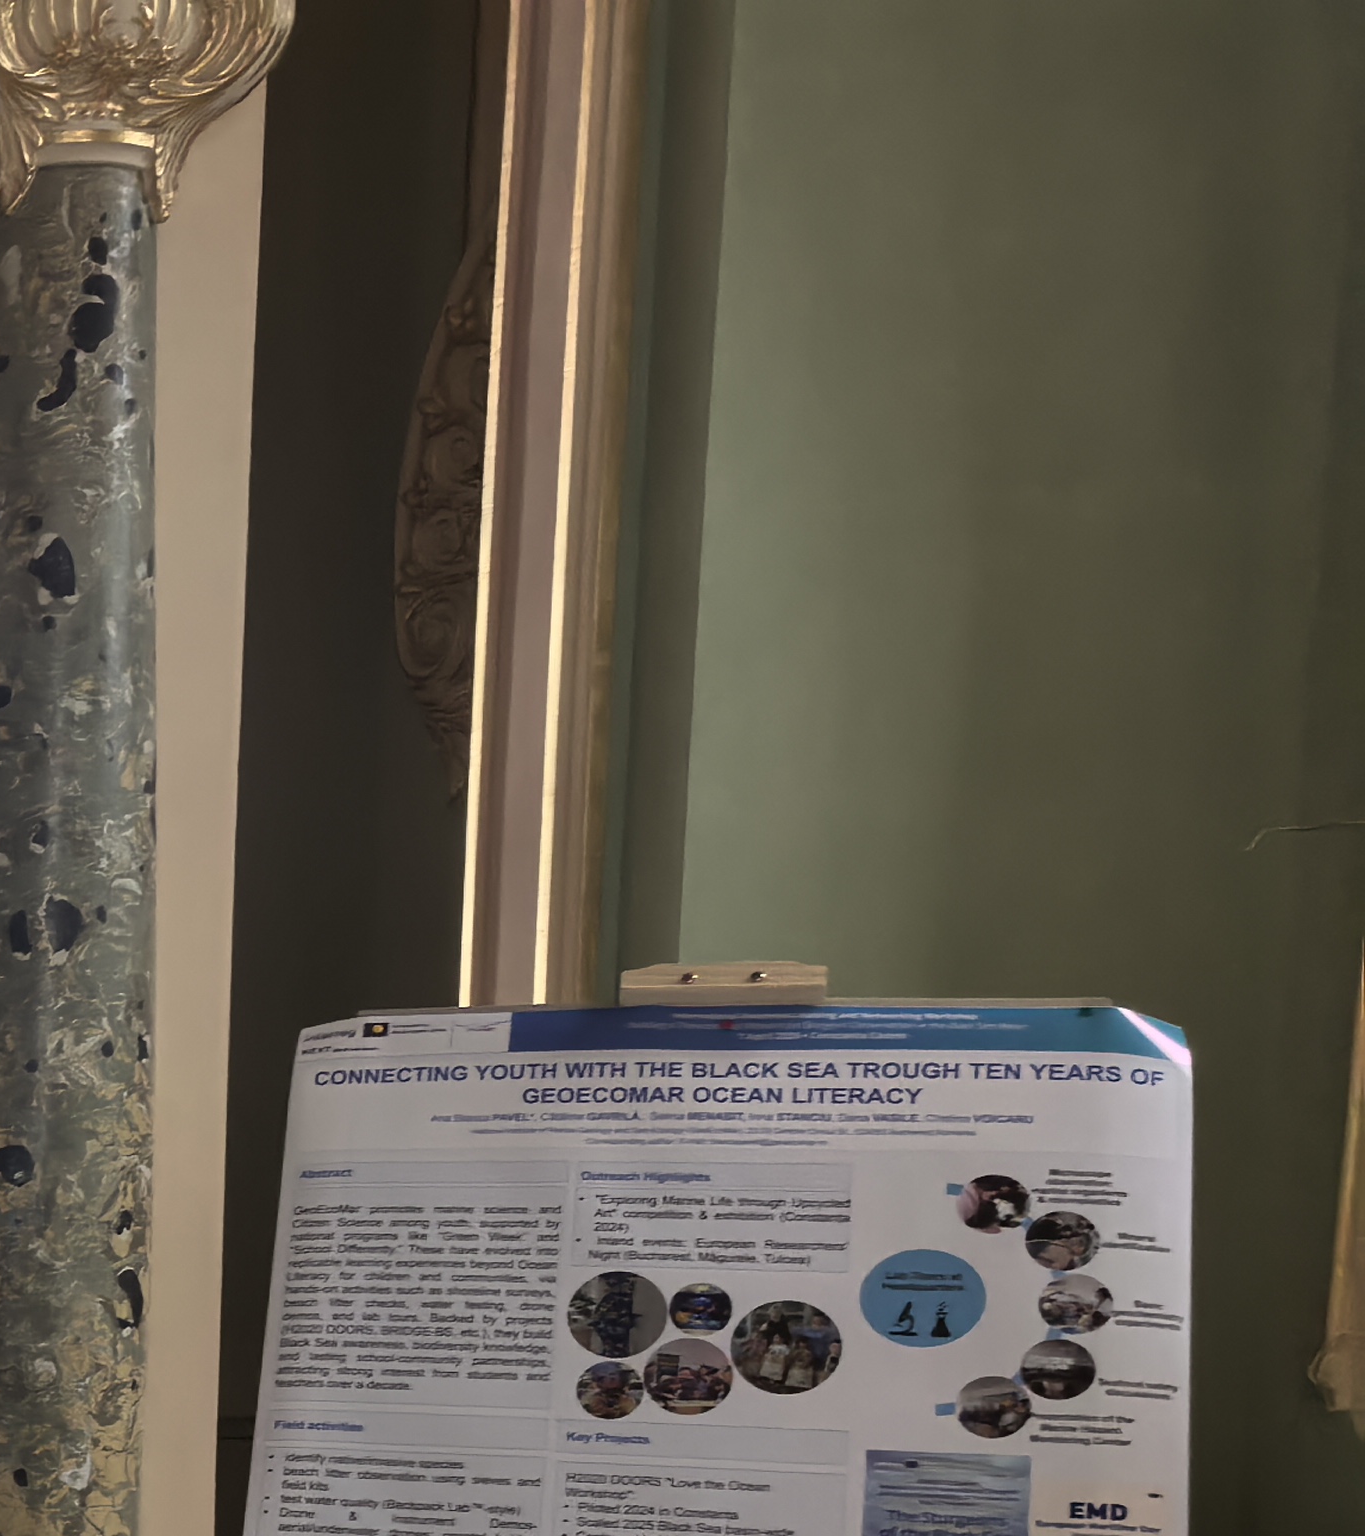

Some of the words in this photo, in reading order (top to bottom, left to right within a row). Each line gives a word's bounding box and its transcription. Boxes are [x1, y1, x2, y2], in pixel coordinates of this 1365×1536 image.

[315, 1066, 468, 1086] CONNECTING
[475, 1063, 557, 1080] YOUTH
[565, 1062, 626, 1078] WITH
[634, 1062, 684, 1078] THE
[691, 1063, 779, 1078] BLACK
[787, 1062, 839, 1078] SEA
[848, 1062, 961, 1079] TROUGH
[969, 1063, 1021, 1079] TEN
[1030, 1064, 1121, 1082] YEARS
[1130, 1069, 1164, 1086] OF
[522, 1087, 684, 1104] GEOECOMAR
[693, 1087, 782, 1103] OCEAN
[792, 1088, 923, 1104] LITERACY
[545, 1220, 561, 1230] by
[1069, 1502, 1127, 1521] EMD
